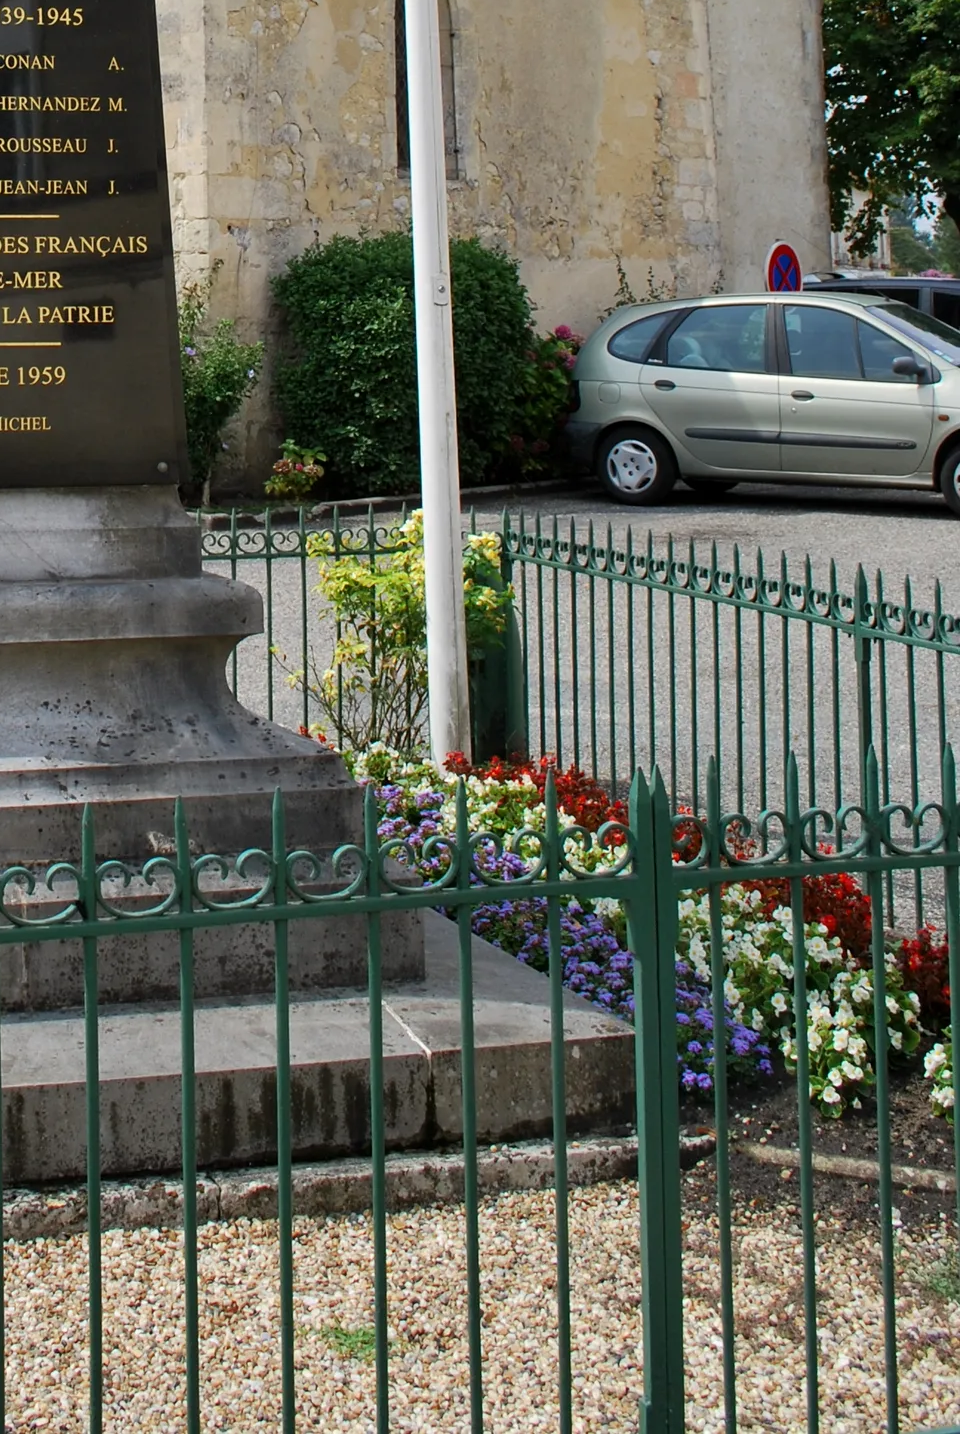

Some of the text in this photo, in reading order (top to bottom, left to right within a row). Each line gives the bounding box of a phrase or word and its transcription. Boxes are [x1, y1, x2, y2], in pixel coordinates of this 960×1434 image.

[108, 57, 125, 71] A.
[108, 98, 129, 112] M.
[107, 139, 119, 154] J.
[107, 181, 120, 195] J.
[33, 236, 148, 258] FRANÇAIS
[0, 306, 34, 326] LA
[36, 306, 115, 326] PATRIE
[16, 366, 67, 386] 1959
